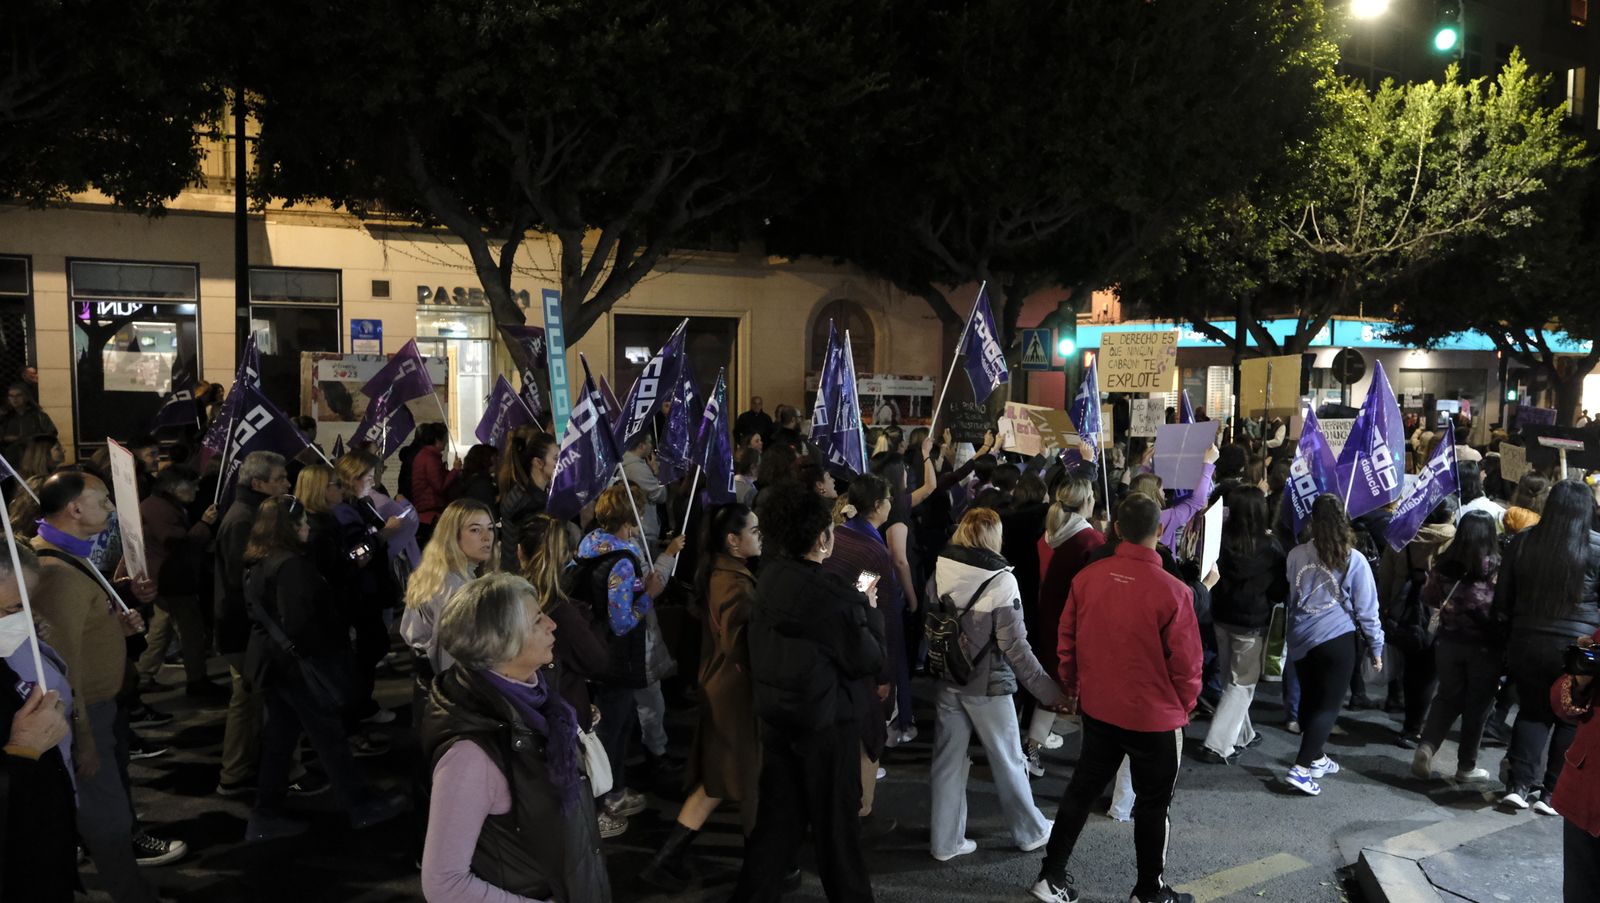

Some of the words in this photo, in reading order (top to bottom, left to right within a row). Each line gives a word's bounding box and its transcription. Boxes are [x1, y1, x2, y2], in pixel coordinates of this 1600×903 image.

[417, 285, 491, 306] PASE
[1103, 335, 1114, 345] EL
[1120, 333, 1158, 345] DERECHO
[1162, 332, 1175, 345] ES
[545, 296, 569, 416] CCOO
[1107, 372, 1160, 388] EXPLOTE
